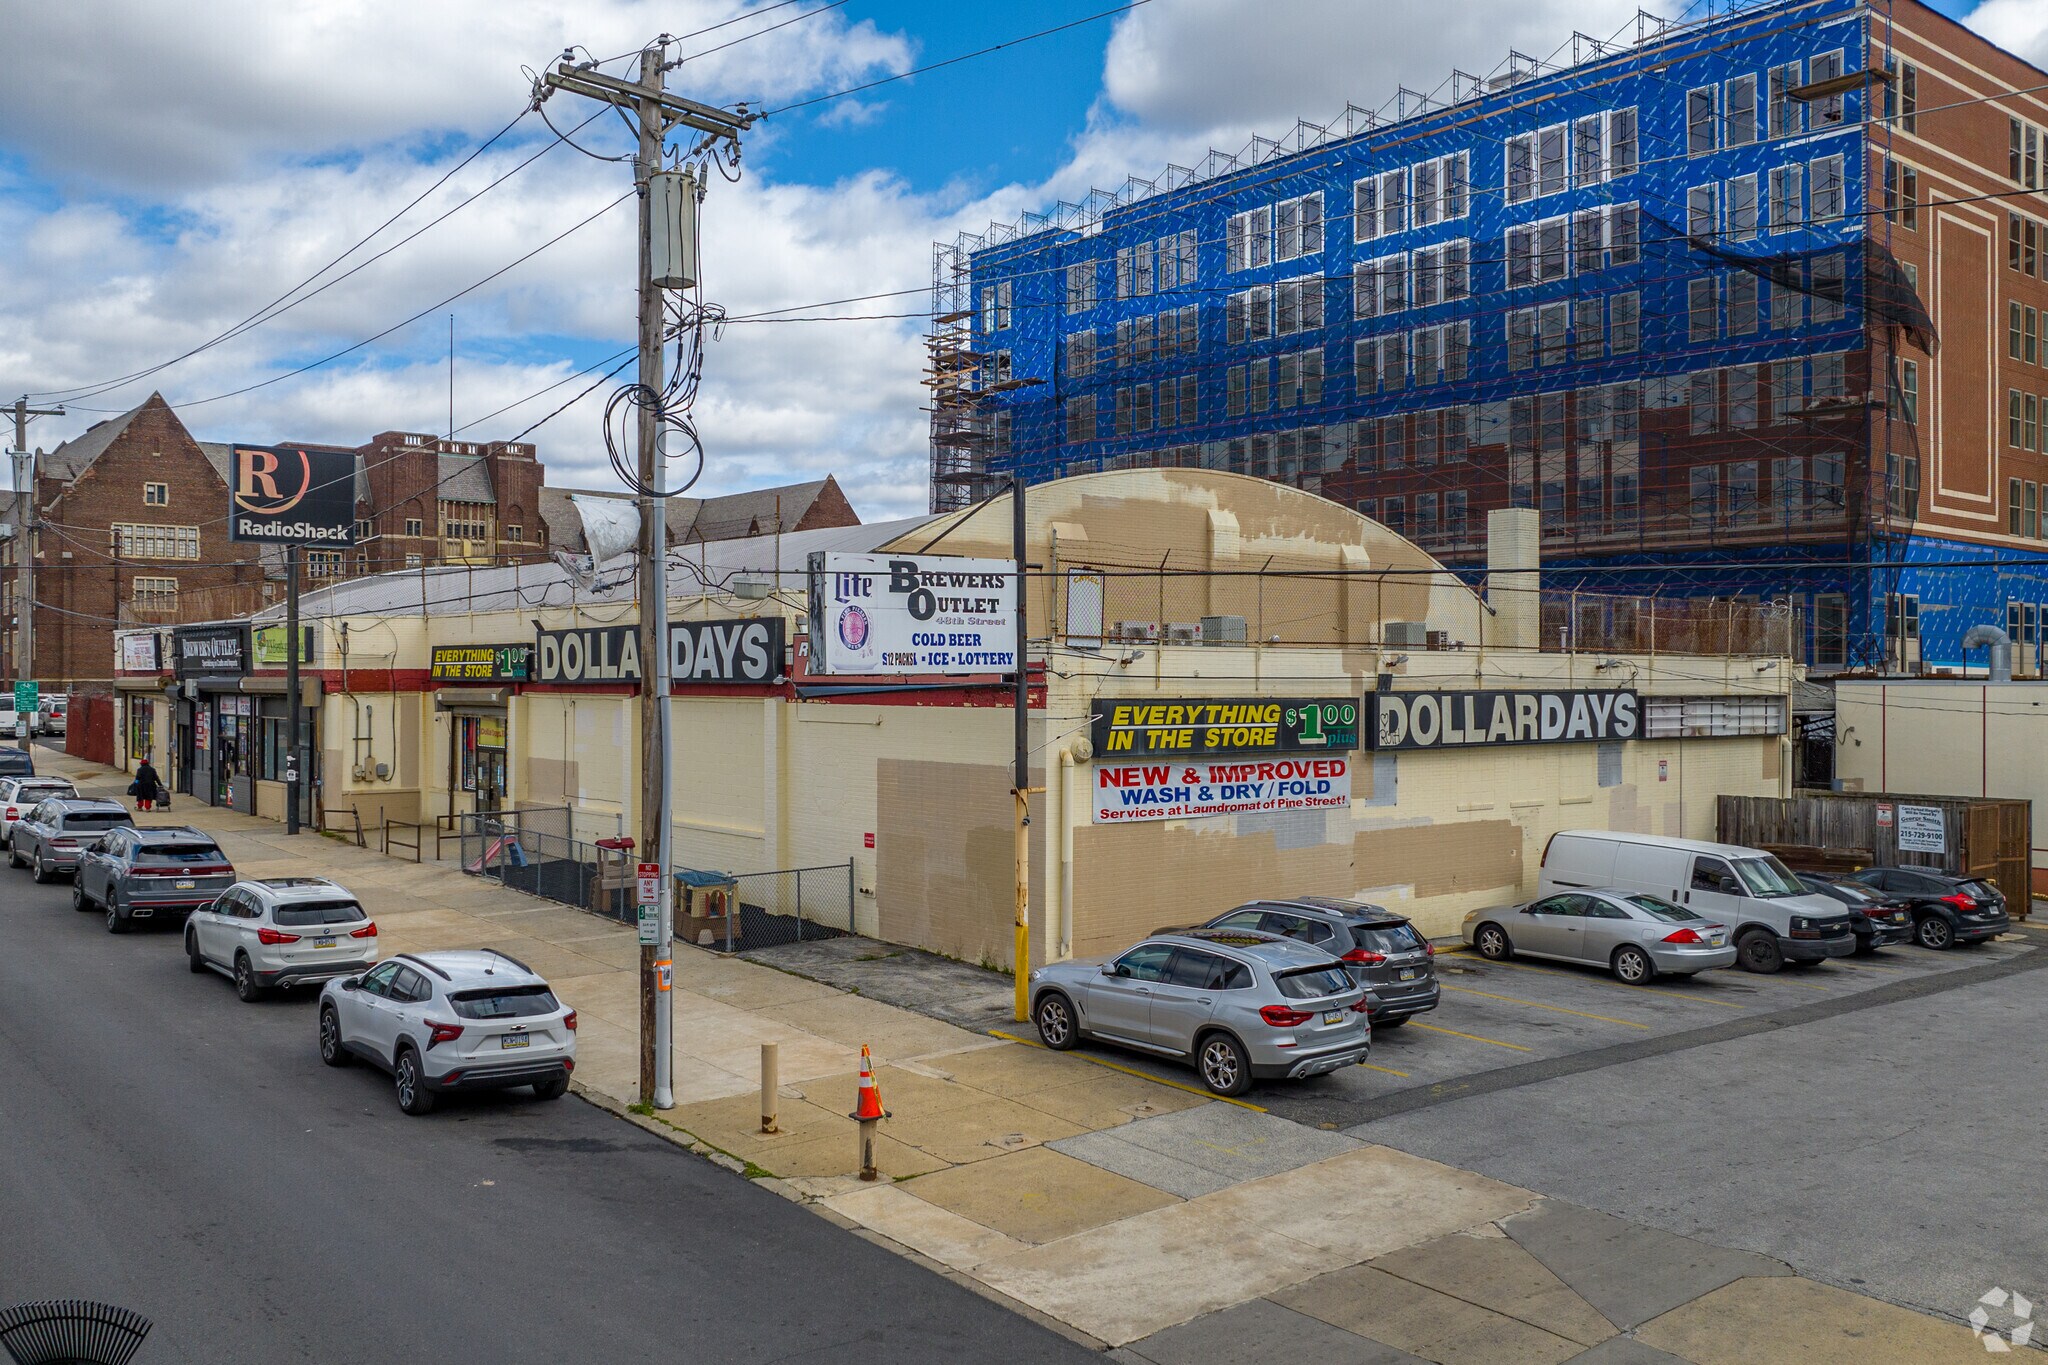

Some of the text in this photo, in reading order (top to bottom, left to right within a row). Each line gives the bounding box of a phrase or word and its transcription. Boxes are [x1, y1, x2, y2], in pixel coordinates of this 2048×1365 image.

[239, 519, 348, 541] RadioShack
[889, 560, 1005, 593] BREWERS
[834, 572, 873, 604] Lite
[907, 587, 1000, 621] OUTLET
[935, 616, 1006, 626] 48th Street
[211, 637, 237, 658] OUTLET
[911, 633, 982, 647] COLD BEER
[435, 648, 494, 662] EVERYTHING
[928, 652, 949, 666] ICE
[958, 652, 1014, 666] LOTTERY
[432, 664, 493, 677] IN THE STORE
[512, 665, 526, 679] plus
[1112, 704, 1281, 725] EVERYTHING
[1107, 727, 1278, 750] IN THE STORE
[1327, 728, 1356, 748] plus
[1099, 760, 1346, 788] NEW & IMPROVED
[1120, 787, 1191, 805] WASH
[1198, 785, 1214, 801] &
[1100, 795, 1346, 819] Services at Laundromat of Pine Street!
[1923, 817, 1941, 825] Smith
[1900, 830, 1942, 840] 215-729-9100
